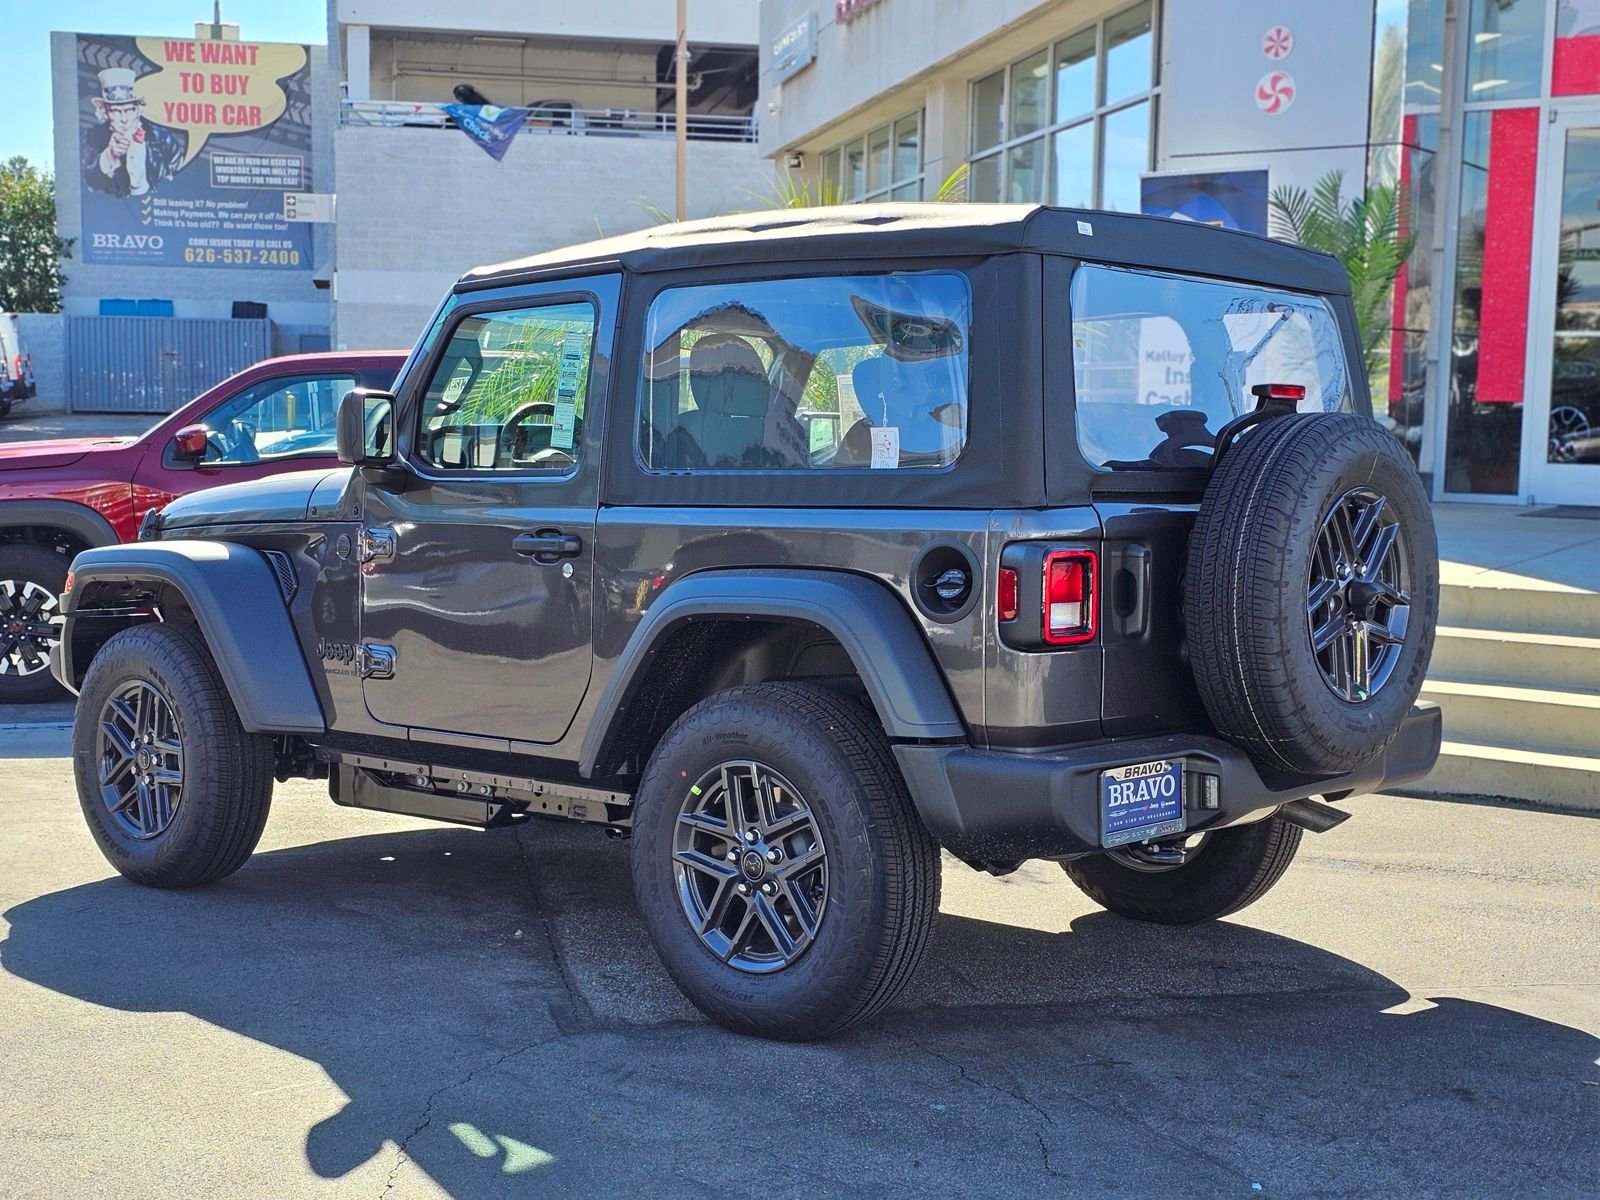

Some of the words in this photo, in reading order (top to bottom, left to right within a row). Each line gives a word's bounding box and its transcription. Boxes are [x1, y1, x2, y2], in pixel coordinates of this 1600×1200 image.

[164, 41, 196, 63] WE
[200, 42, 259, 66] WANT
[179, 72, 204, 94] TO
[210, 74, 250, 96] BUY
[163, 102, 216, 124] YOUR
[222, 104, 262, 126] CAR
[213, 156, 223, 165] WE
[271, 158, 286, 166] USED
[287, 159, 300, 167] CAR
[251, 167, 260, 175] SO
[272, 168, 286, 176] WILL
[216, 176, 229, 184] TOP
[230, 176, 251, 184] MONEY
[252, 177, 264, 185] FOR
[265, 177, 282, 185] YOUR
[154, 198, 167, 207] Still
[168, 199, 194, 209] leasing
[195, 200, 204, 208] it?
[206, 200, 216, 208] No
[217, 201, 248, 210] problem!
[153, 209, 178, 218] Making
[218, 211, 229, 219] We
[244, 213, 257, 221] pay
[258, 212, 264, 220] it
[265, 212, 274, 220] off
[154, 219, 173, 228] Think
[175, 220, 185, 228] it's
[200, 221, 219, 229] old??
[236, 222, 252, 230] want
[254, 222, 272, 231] those
[274, 223, 288, 231] too!
[92, 234, 164, 249] BRAVO
[188, 238, 208, 247] COME
[209, 238, 233, 247] INSIDE
[233, 238, 255, 248] TODAY
[255, 239, 265, 248] OR
[266, 239, 284, 248] CALL
[285, 240, 293, 249] US
[184, 248, 300, 266] 626-537-2400
[1145, 351, 1186, 363] Kelley
[1406, 576, 1434, 689] NEXEN
[317, 637, 354, 666] Jeep
[703, 731, 748, 745] All-Weather
[1124, 762, 1162, 778] BRAVO
[1108, 774, 1176, 807] BRAVO
